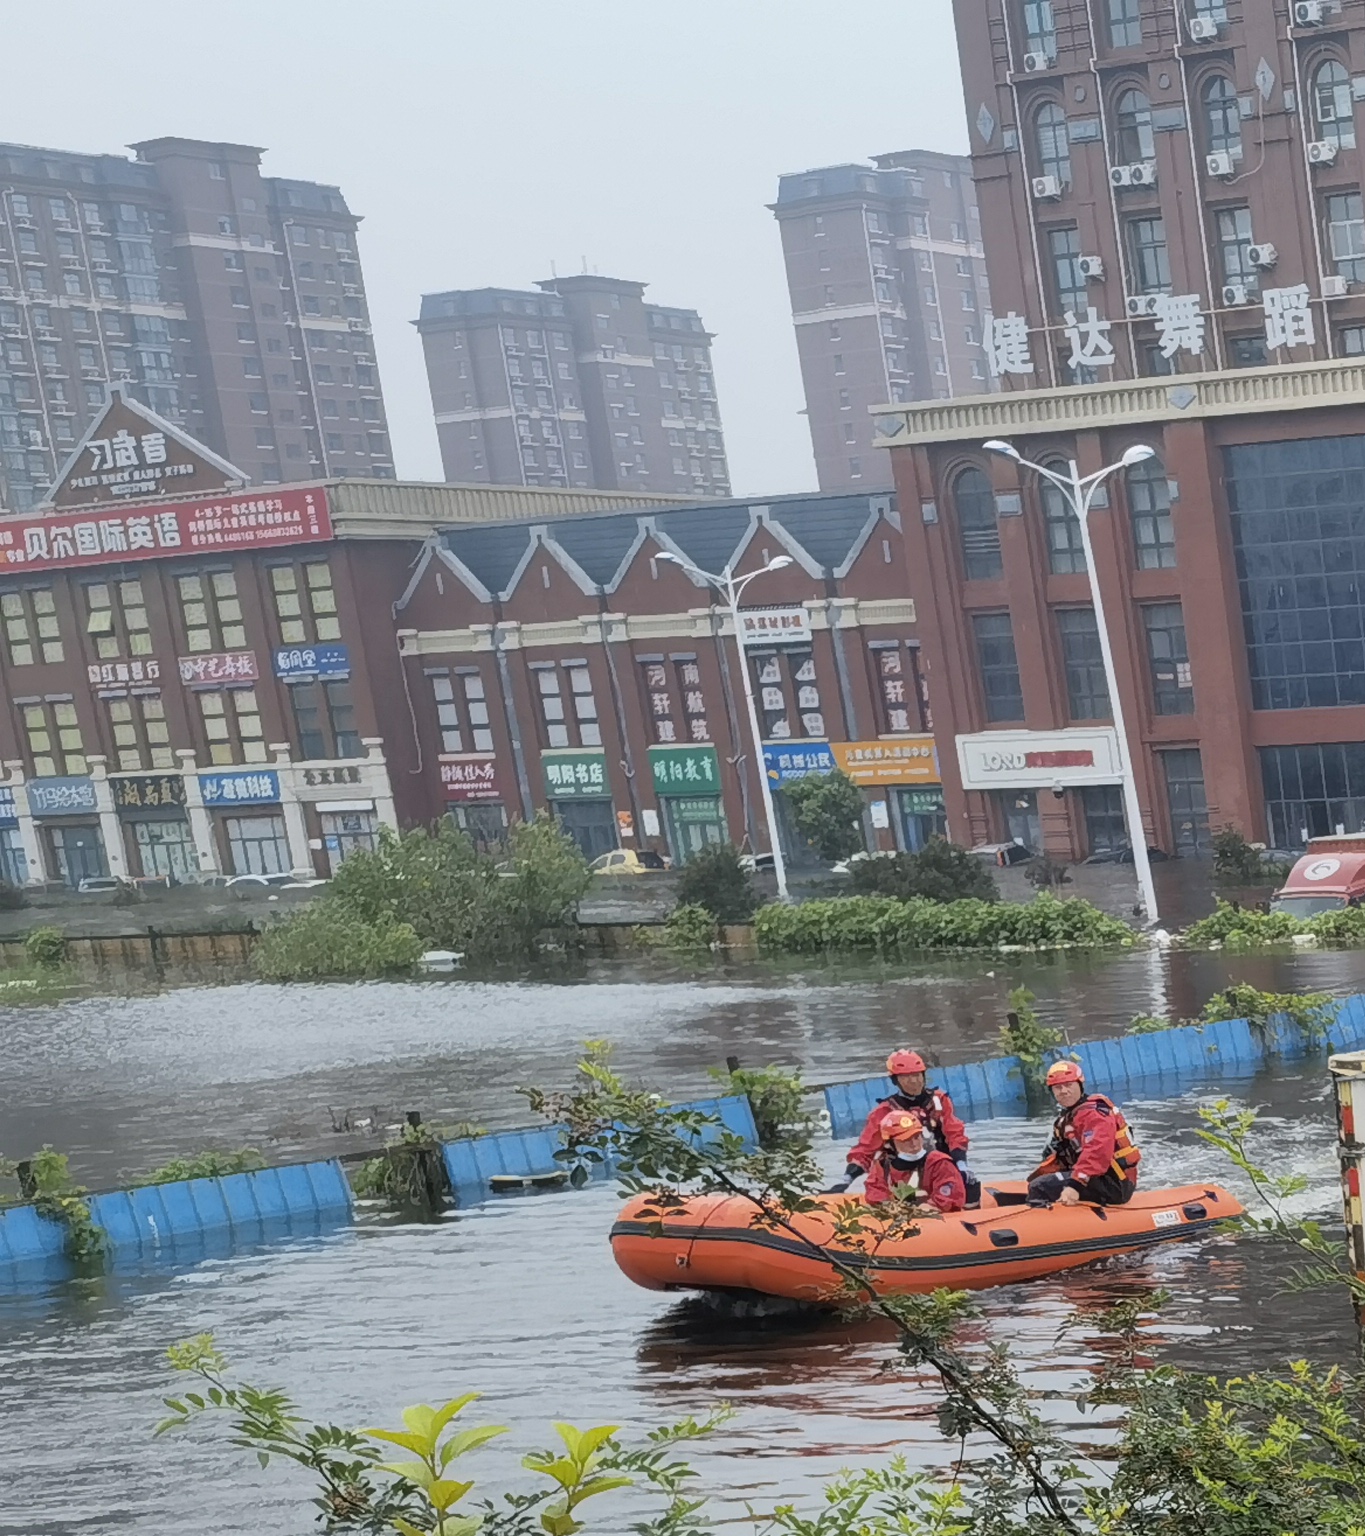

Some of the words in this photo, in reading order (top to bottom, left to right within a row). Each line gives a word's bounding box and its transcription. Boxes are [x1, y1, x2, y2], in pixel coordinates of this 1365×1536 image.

[23, 512, 181, 562] 贝尔国际英语
[546, 762, 604, 785] 明阳书店
[653, 755, 714, 784] 明阳教育
